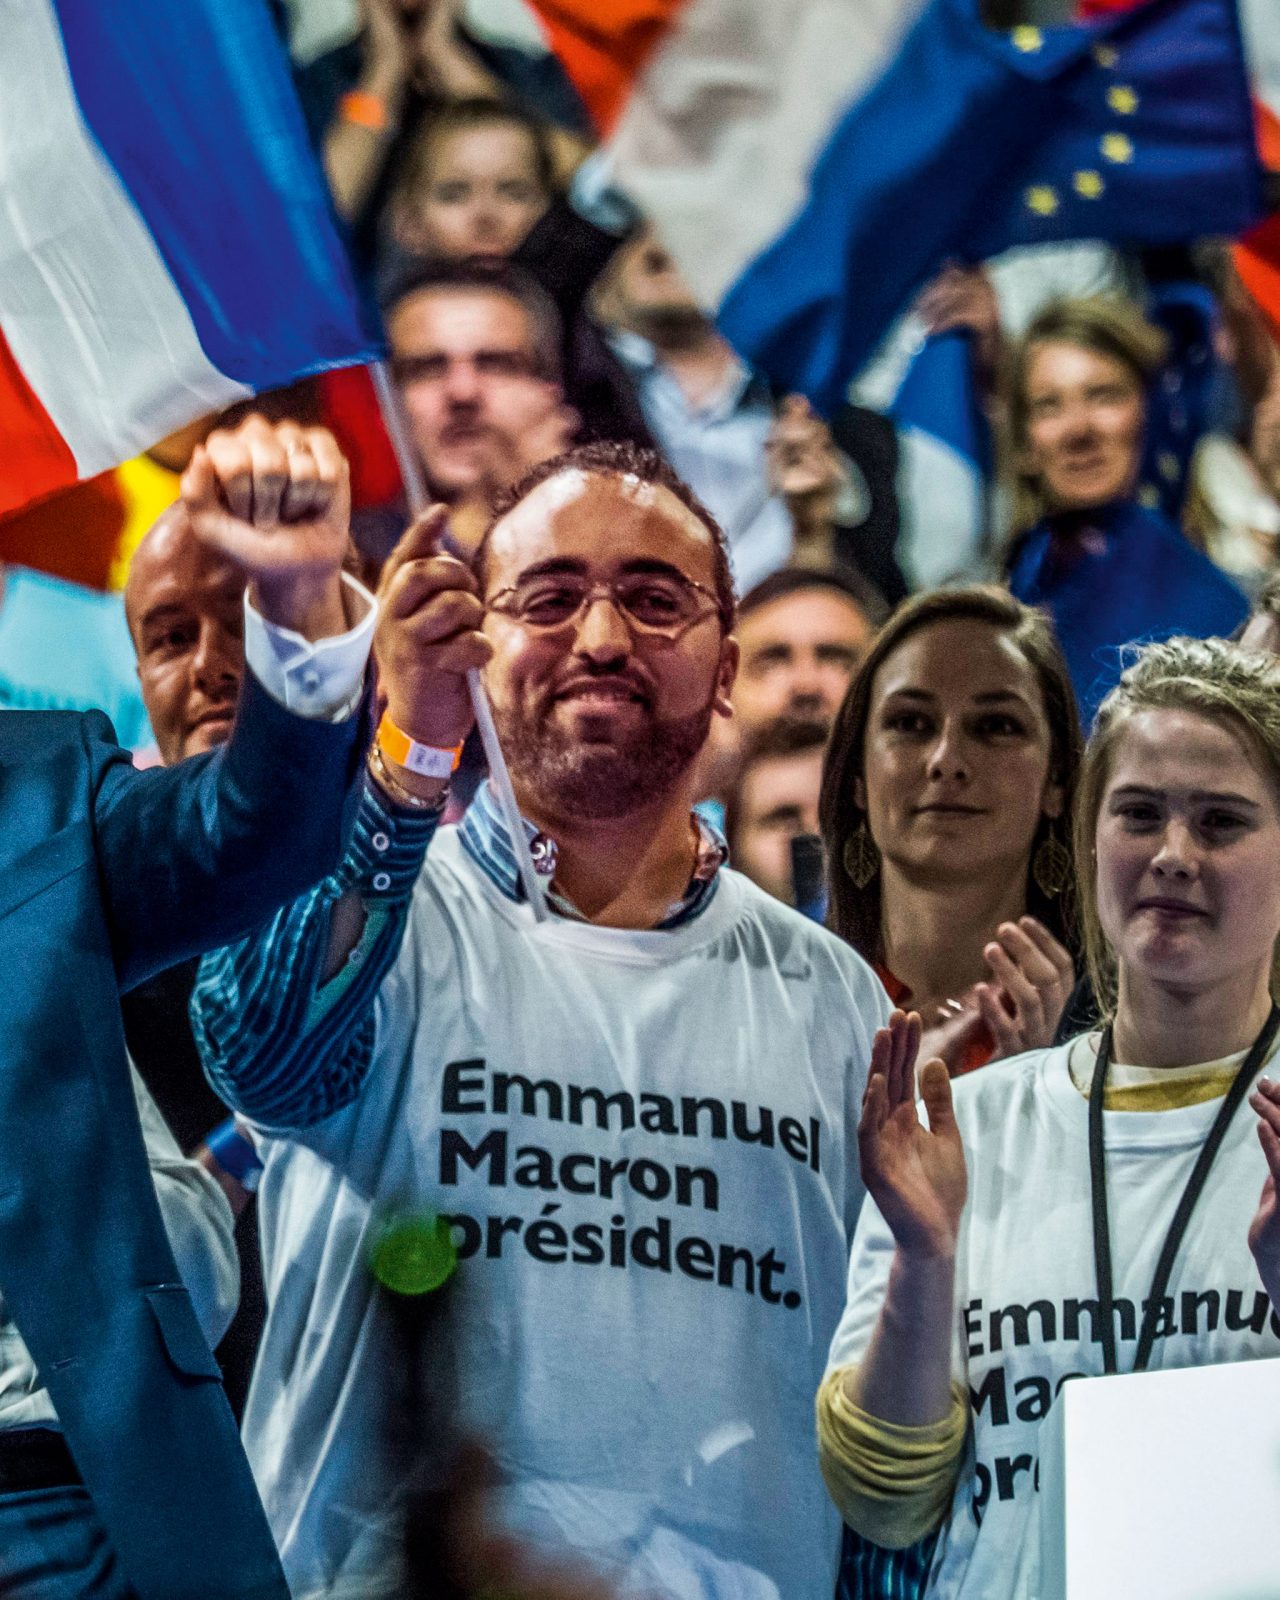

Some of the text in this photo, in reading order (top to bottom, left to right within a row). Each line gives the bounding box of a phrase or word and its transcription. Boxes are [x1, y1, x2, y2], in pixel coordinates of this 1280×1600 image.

[441, 1058, 820, 1173] Emmanuel
[438, 1128, 719, 1211] Macron
[436, 1203, 802, 1310] président.
